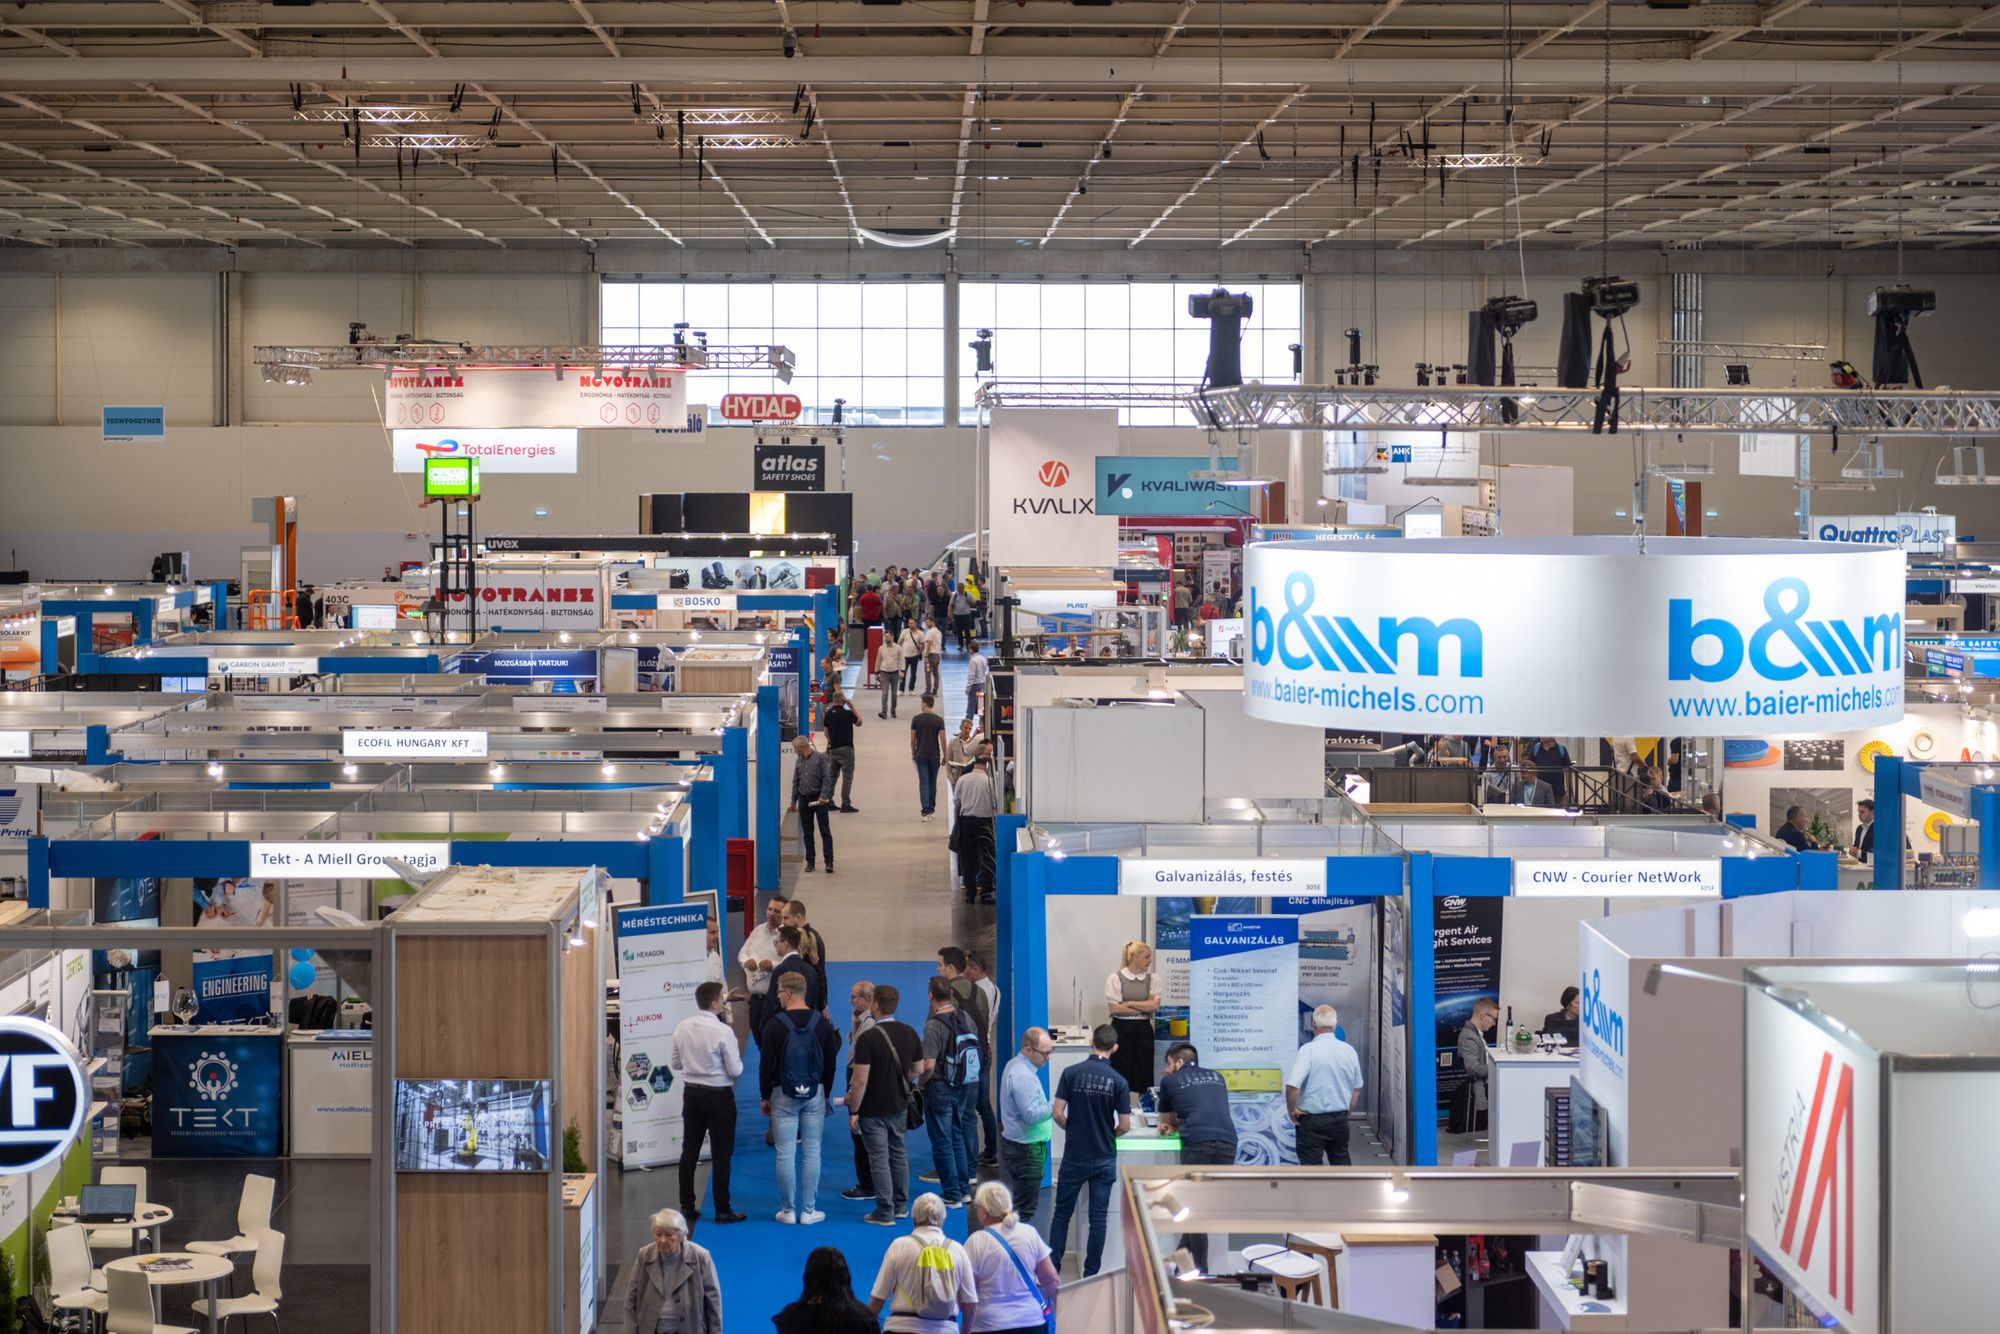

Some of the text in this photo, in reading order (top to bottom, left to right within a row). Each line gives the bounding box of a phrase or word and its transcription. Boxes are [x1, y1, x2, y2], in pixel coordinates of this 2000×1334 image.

[724, 396, 797, 418] HYDAC
[462, 444, 555, 458] TotalEnergies
[762, 454, 818, 472] atlas
[1013, 498, 1094, 514] KVALIX
[487, 539, 519, 549] uvex
[325, 596, 349, 604] 403C
[684, 597, 720, 606] BOSKO
[489, 608, 544, 616] HATÉKONYSÁG
[551, 608, 594, 616] BIZTONSÁG
[1251, 678, 1484, 714] www.baier-michels.com
[358, 738, 470, 748] ECOFIL HUNGARY KFT
[261, 853, 291, 865] Tekt
[304, 853, 314, 865] A
[318, 852, 352, 865] Miell
[356, 853, 399, 865] Gro
[403, 853, 437, 868] tagja
[1155, 870, 1293, 884] Galvanizálás, festés
[1532, 871, 1568, 883] CNW
[1581, 871, 1634, 883] Courier
[1638, 871, 1702, 883] NetWork
[1288, 897, 1310, 905] CNC
[1444, 898, 1468, 907] CNW
[622, 914, 704, 929] MÉRÉSTECHNIKA
[1434, 925, 1479, 938] rgent Air
[1204, 936, 1284, 944] GALVANIZÁLÁS
[1450, 936, 1493, 946] Services
[636, 950, 665, 959] HEXAGON
[202, 974, 268, 998] ENGINEERING
[636, 1013, 662, 1023] AUKOM
[169, 1108, 258, 1128] TEKT
[1772, 1090, 1806, 1240] AUSTRIA
